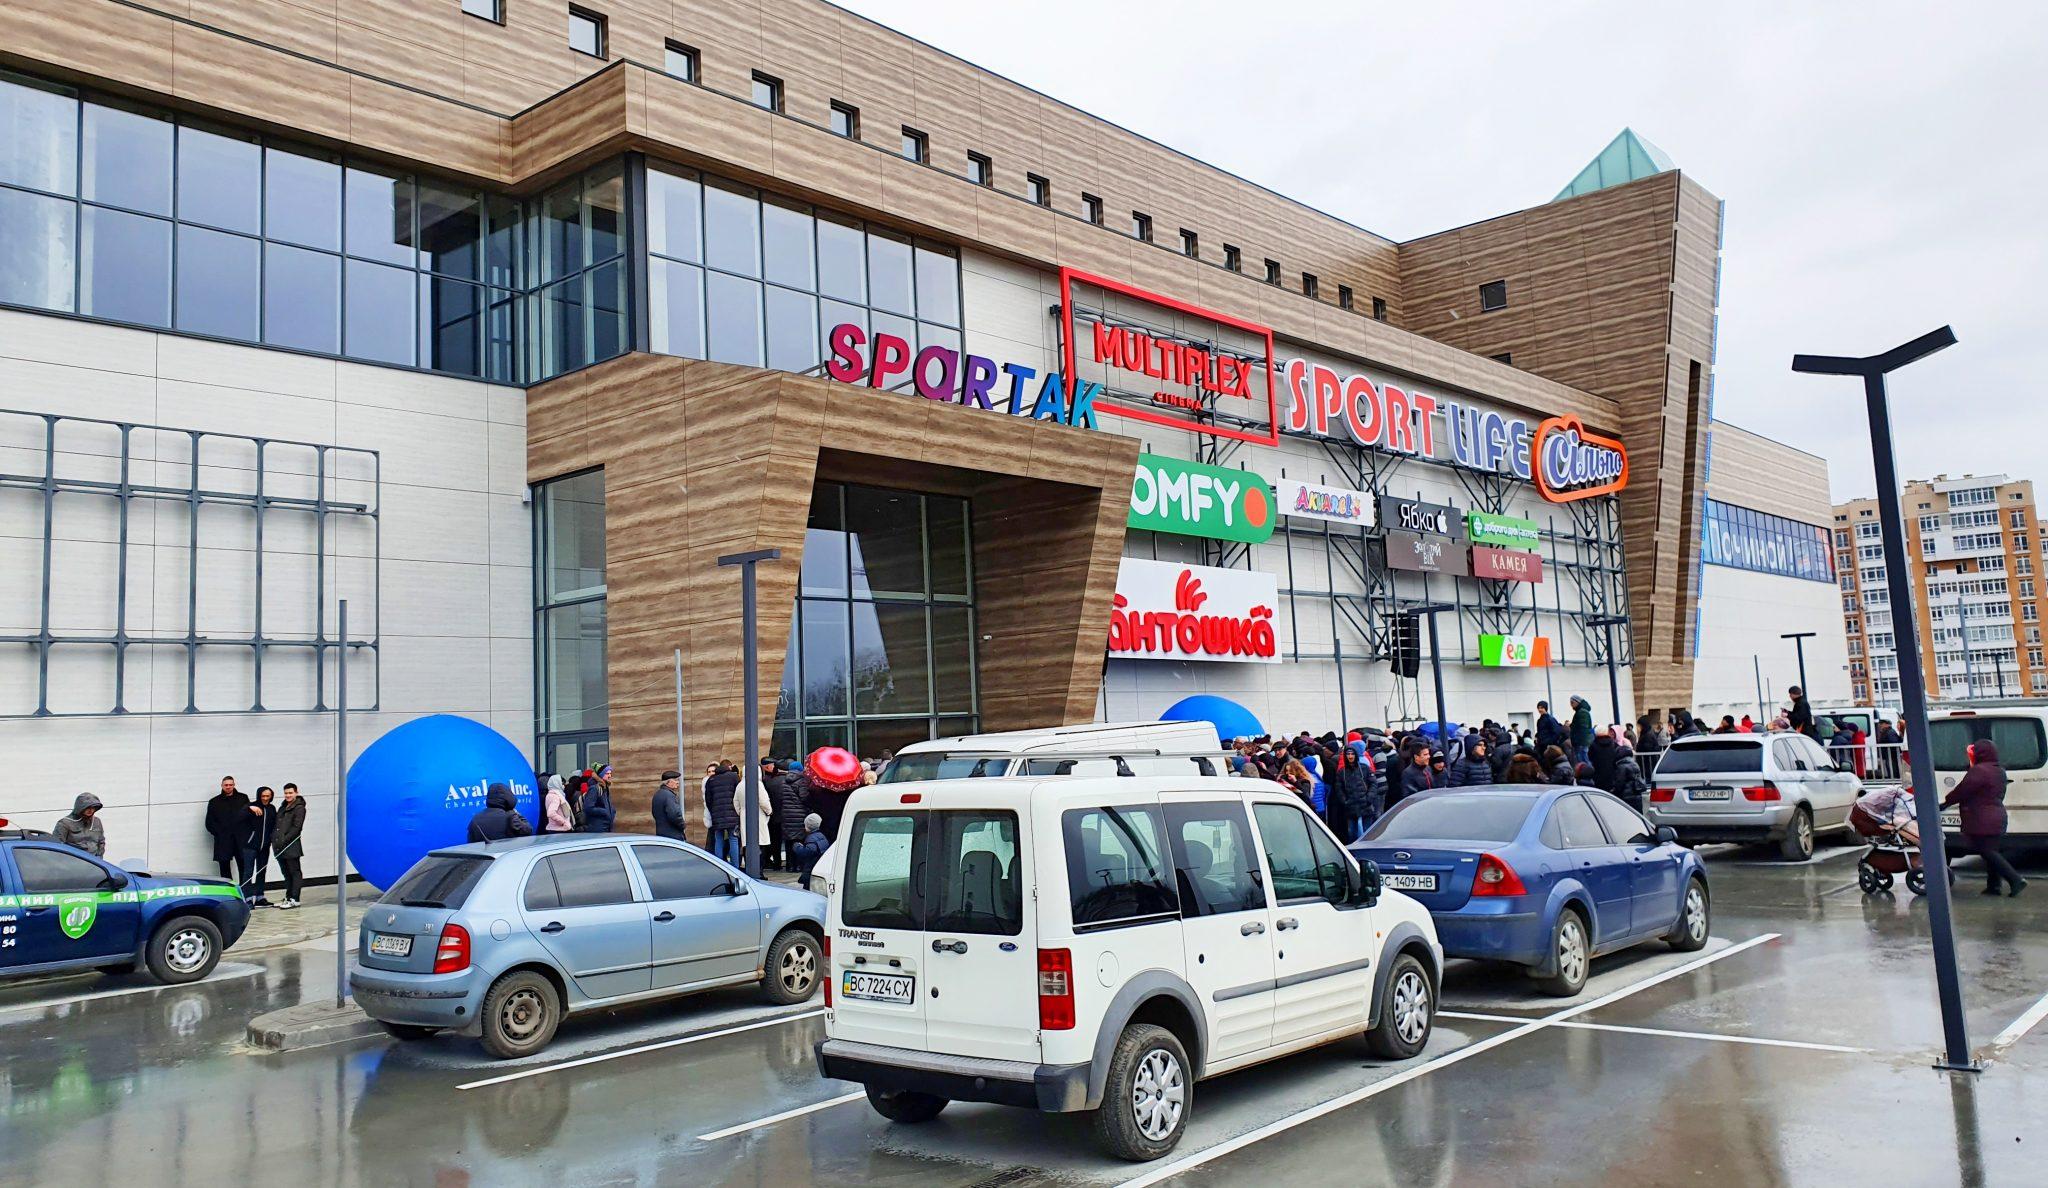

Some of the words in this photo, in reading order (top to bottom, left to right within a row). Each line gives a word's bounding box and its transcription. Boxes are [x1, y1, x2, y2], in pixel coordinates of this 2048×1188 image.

[1093, 322, 1253, 399] MULTIPLEX
[1153, 391, 1203, 411] CINEMA
[1283, 357, 1438, 459] SPORT
[1445, 401, 1532, 479] LIFE
[1543, 429, 1623, 488] Сільпо
[1399, 503, 1435, 531] Ябко
[1491, 553, 1527, 573] КАМЕЯ
[445, 779, 488, 800] Aval
[1394, 876, 1416, 887] 1409
[1418, 877, 1433, 888] HB
[838, 928, 876, 940] TRANSIT
[850, 975, 865, 992] BC
[867, 977, 892, 996] 7224
[893, 979, 911, 997] CX
